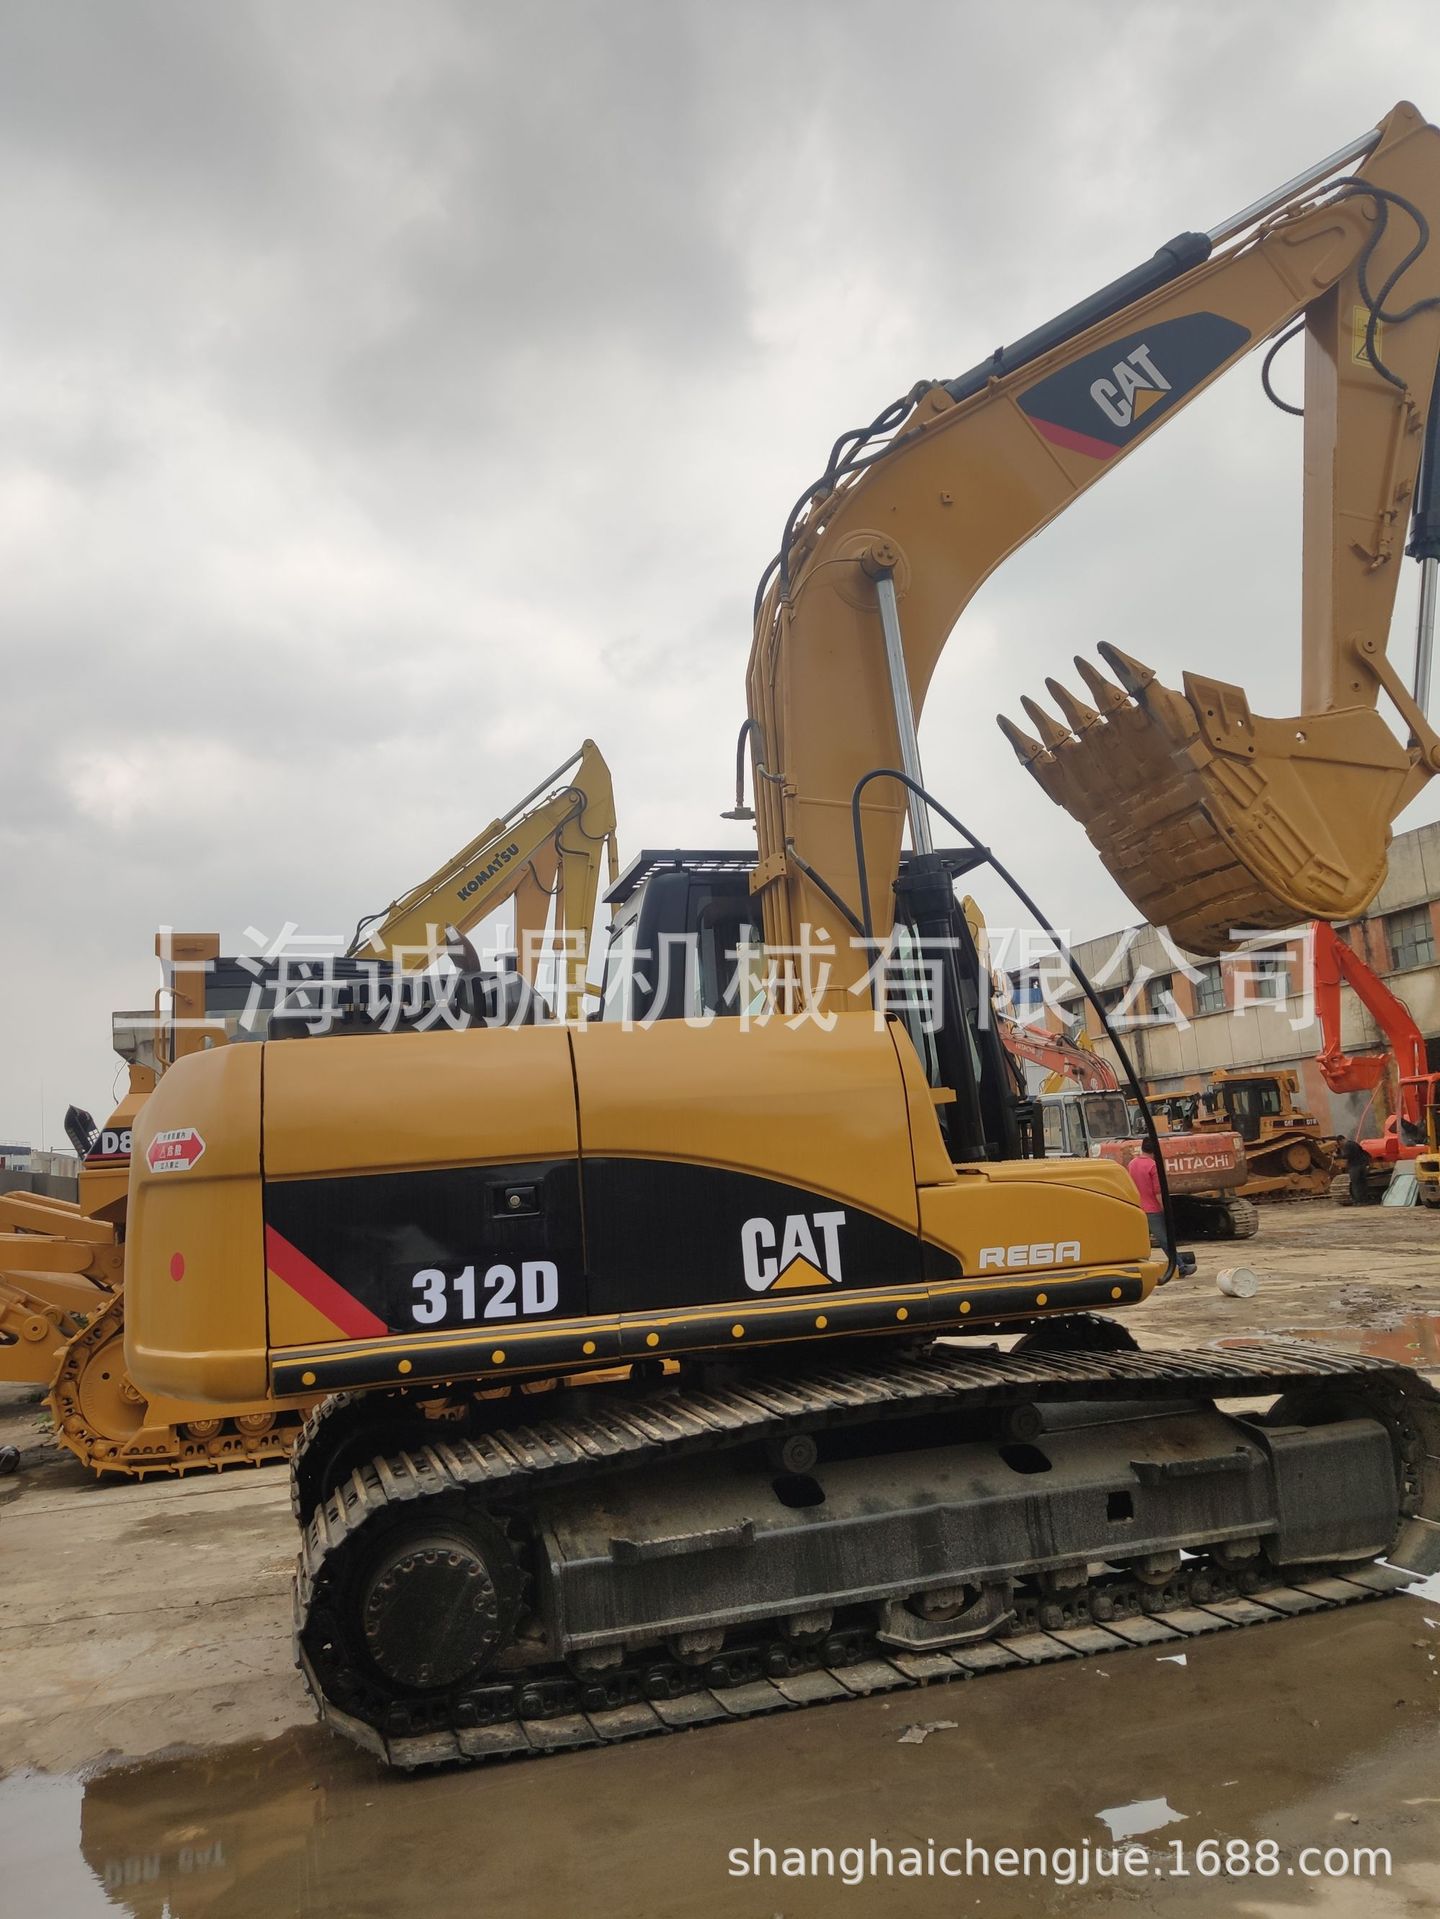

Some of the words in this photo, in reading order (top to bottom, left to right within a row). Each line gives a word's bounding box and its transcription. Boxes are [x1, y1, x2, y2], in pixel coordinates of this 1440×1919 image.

[1090, 344, 1172, 427] CAT
[457, 843, 520, 901] KOMATSU
[741, 1210, 846, 1292] CAT
[979, 1241, 1081, 1269] REGA
[411, 1260, 559, 1324] 312D
